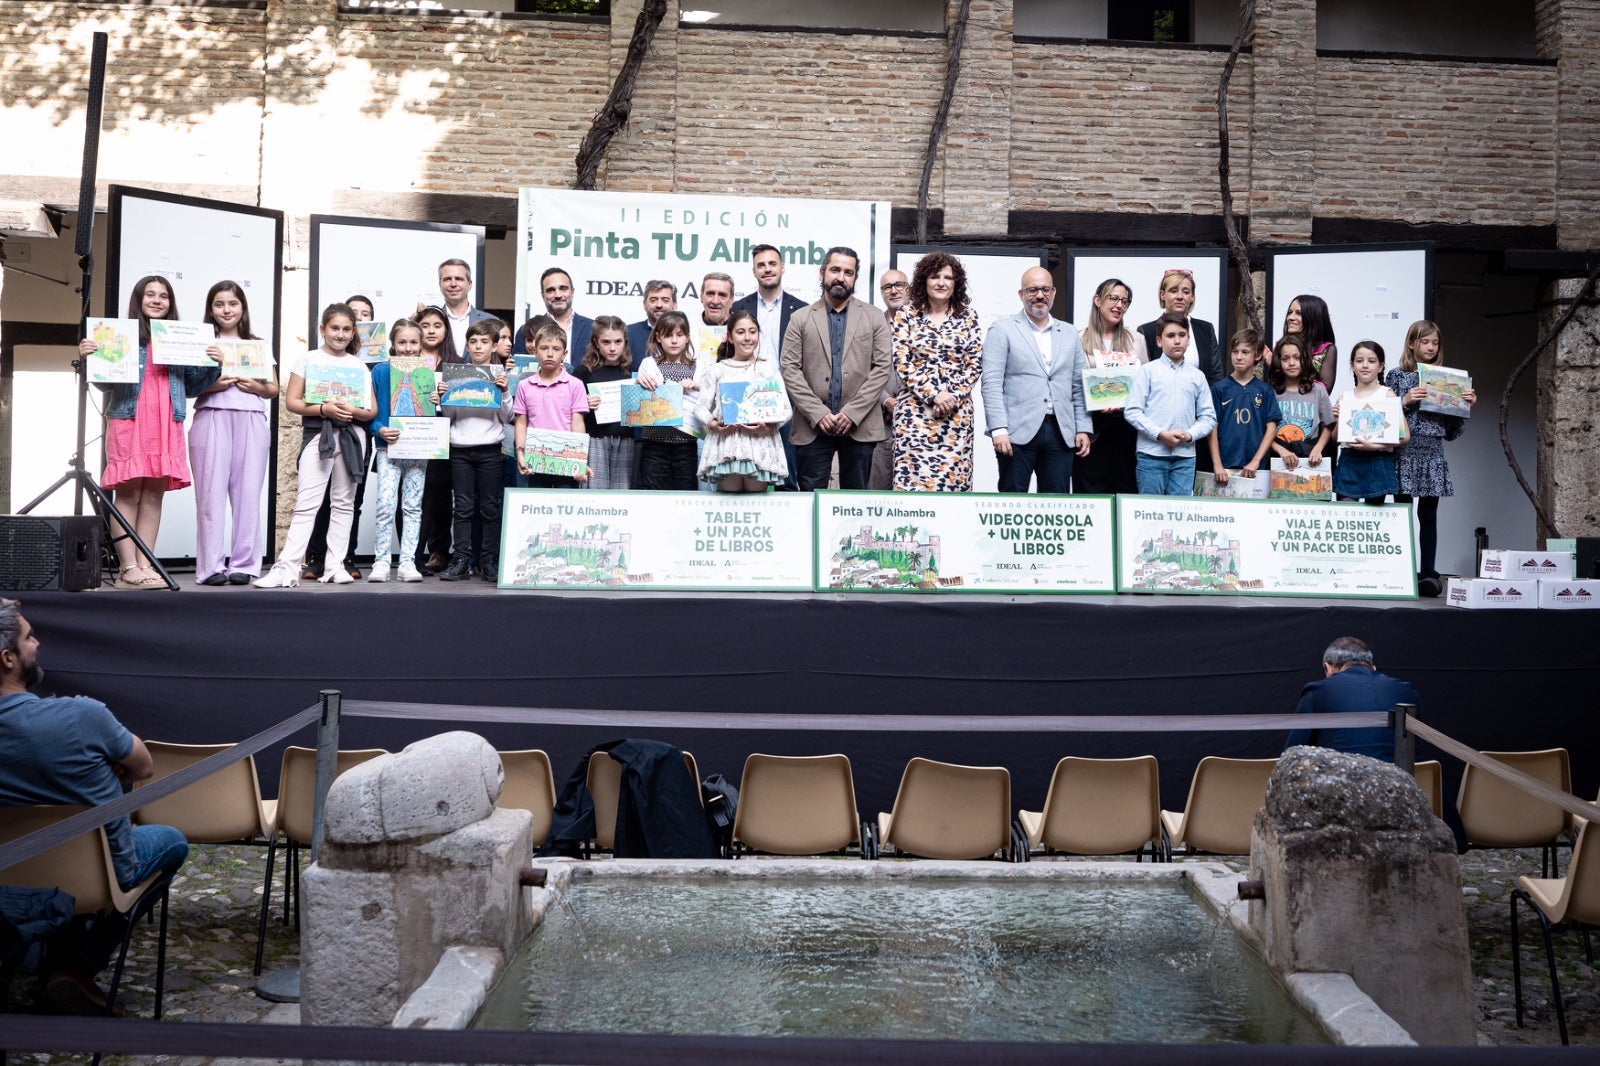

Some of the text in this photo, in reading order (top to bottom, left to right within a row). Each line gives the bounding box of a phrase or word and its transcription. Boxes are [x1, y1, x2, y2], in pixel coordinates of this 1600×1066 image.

[621, 207, 790, 228] II EDICIÓN
[549, 228, 826, 265] Pinta TU Alhmb
[586, 280, 645, 296] IDEA
[1234, 407, 1251, 425] 10
[521, 504, 629, 517] Pinta TU Alhambra
[832, 505, 936, 518] Pinta TU Alhambra
[1133, 509, 1235, 524] Pinta TU Alhambra
[1268, 508, 1316, 516] GANADOR
[1344, 510, 1397, 518] CONCURSO
[705, 511, 761, 524] TABLET
[978, 512, 1094, 527] VIDEOCONSOLA
[1285, 518, 1381, 531] VIAJE A DISNEY
[706, 526, 728, 538] UN
[732, 526, 772, 538] PACK
[1000, 528, 1021, 541] UN
[1025, 529, 1062, 541] PACK
[1066, 529, 1086, 541] DE
[1277, 530, 1391, 543] PARA 4 PERSONAS
[695, 540, 774, 553] DE LIBROS
[1013, 543, 1065, 556] LIBROS
[1270, 541, 1402, 555] Y UN PACK DE LIBROS
[688, 559, 717, 567] IDEAL
[996, 562, 1023, 570] IDEAL
[1296, 567, 1323, 575] IDEAL
